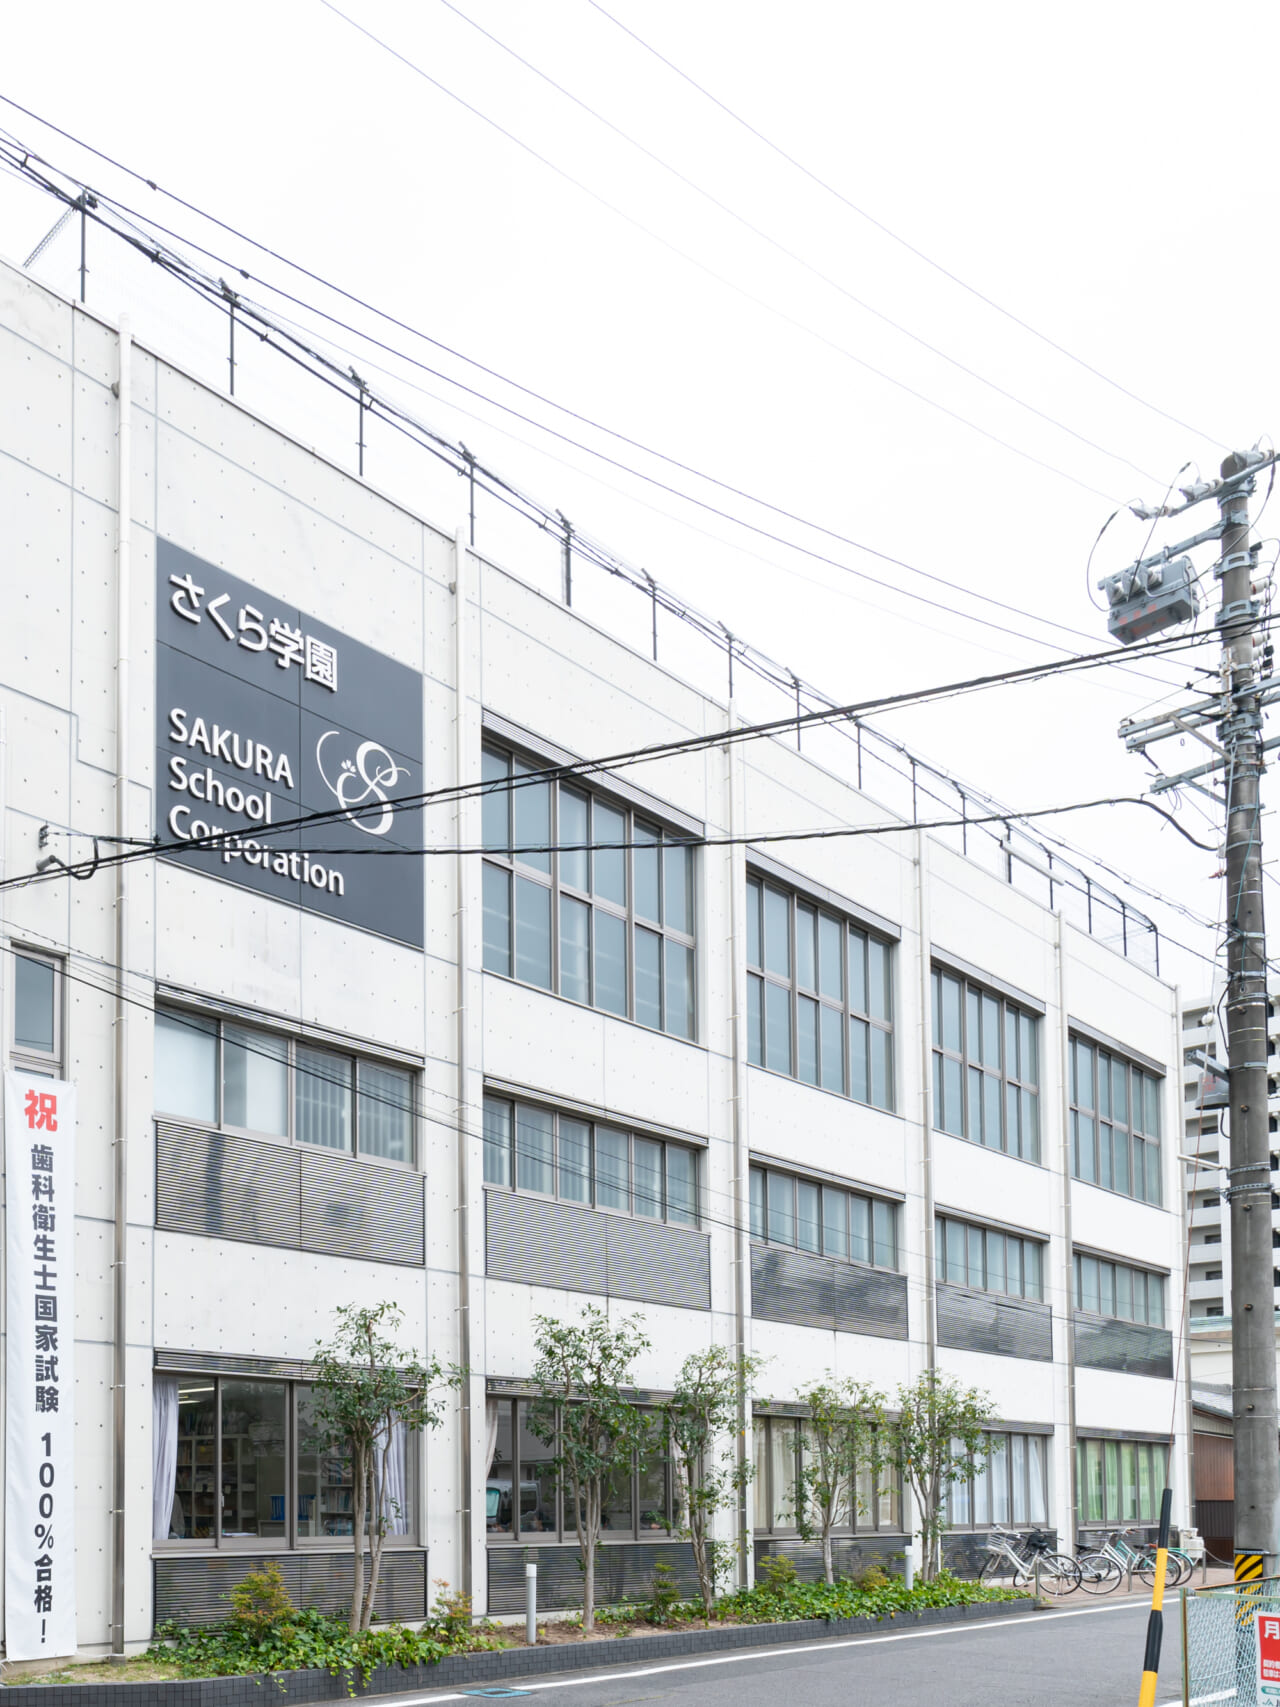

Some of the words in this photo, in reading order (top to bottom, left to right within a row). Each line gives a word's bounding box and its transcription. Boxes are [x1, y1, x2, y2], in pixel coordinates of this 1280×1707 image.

[168, 573, 339, 692] さくら学園
[168, 707, 295, 788] SAKURA
[168, 755, 272, 824] School
[168, 804, 345, 896] Corporation
[24, 1088, 58, 1133] 祝
[30, 1143, 59, 1414] 歯科衛生士国家試験
